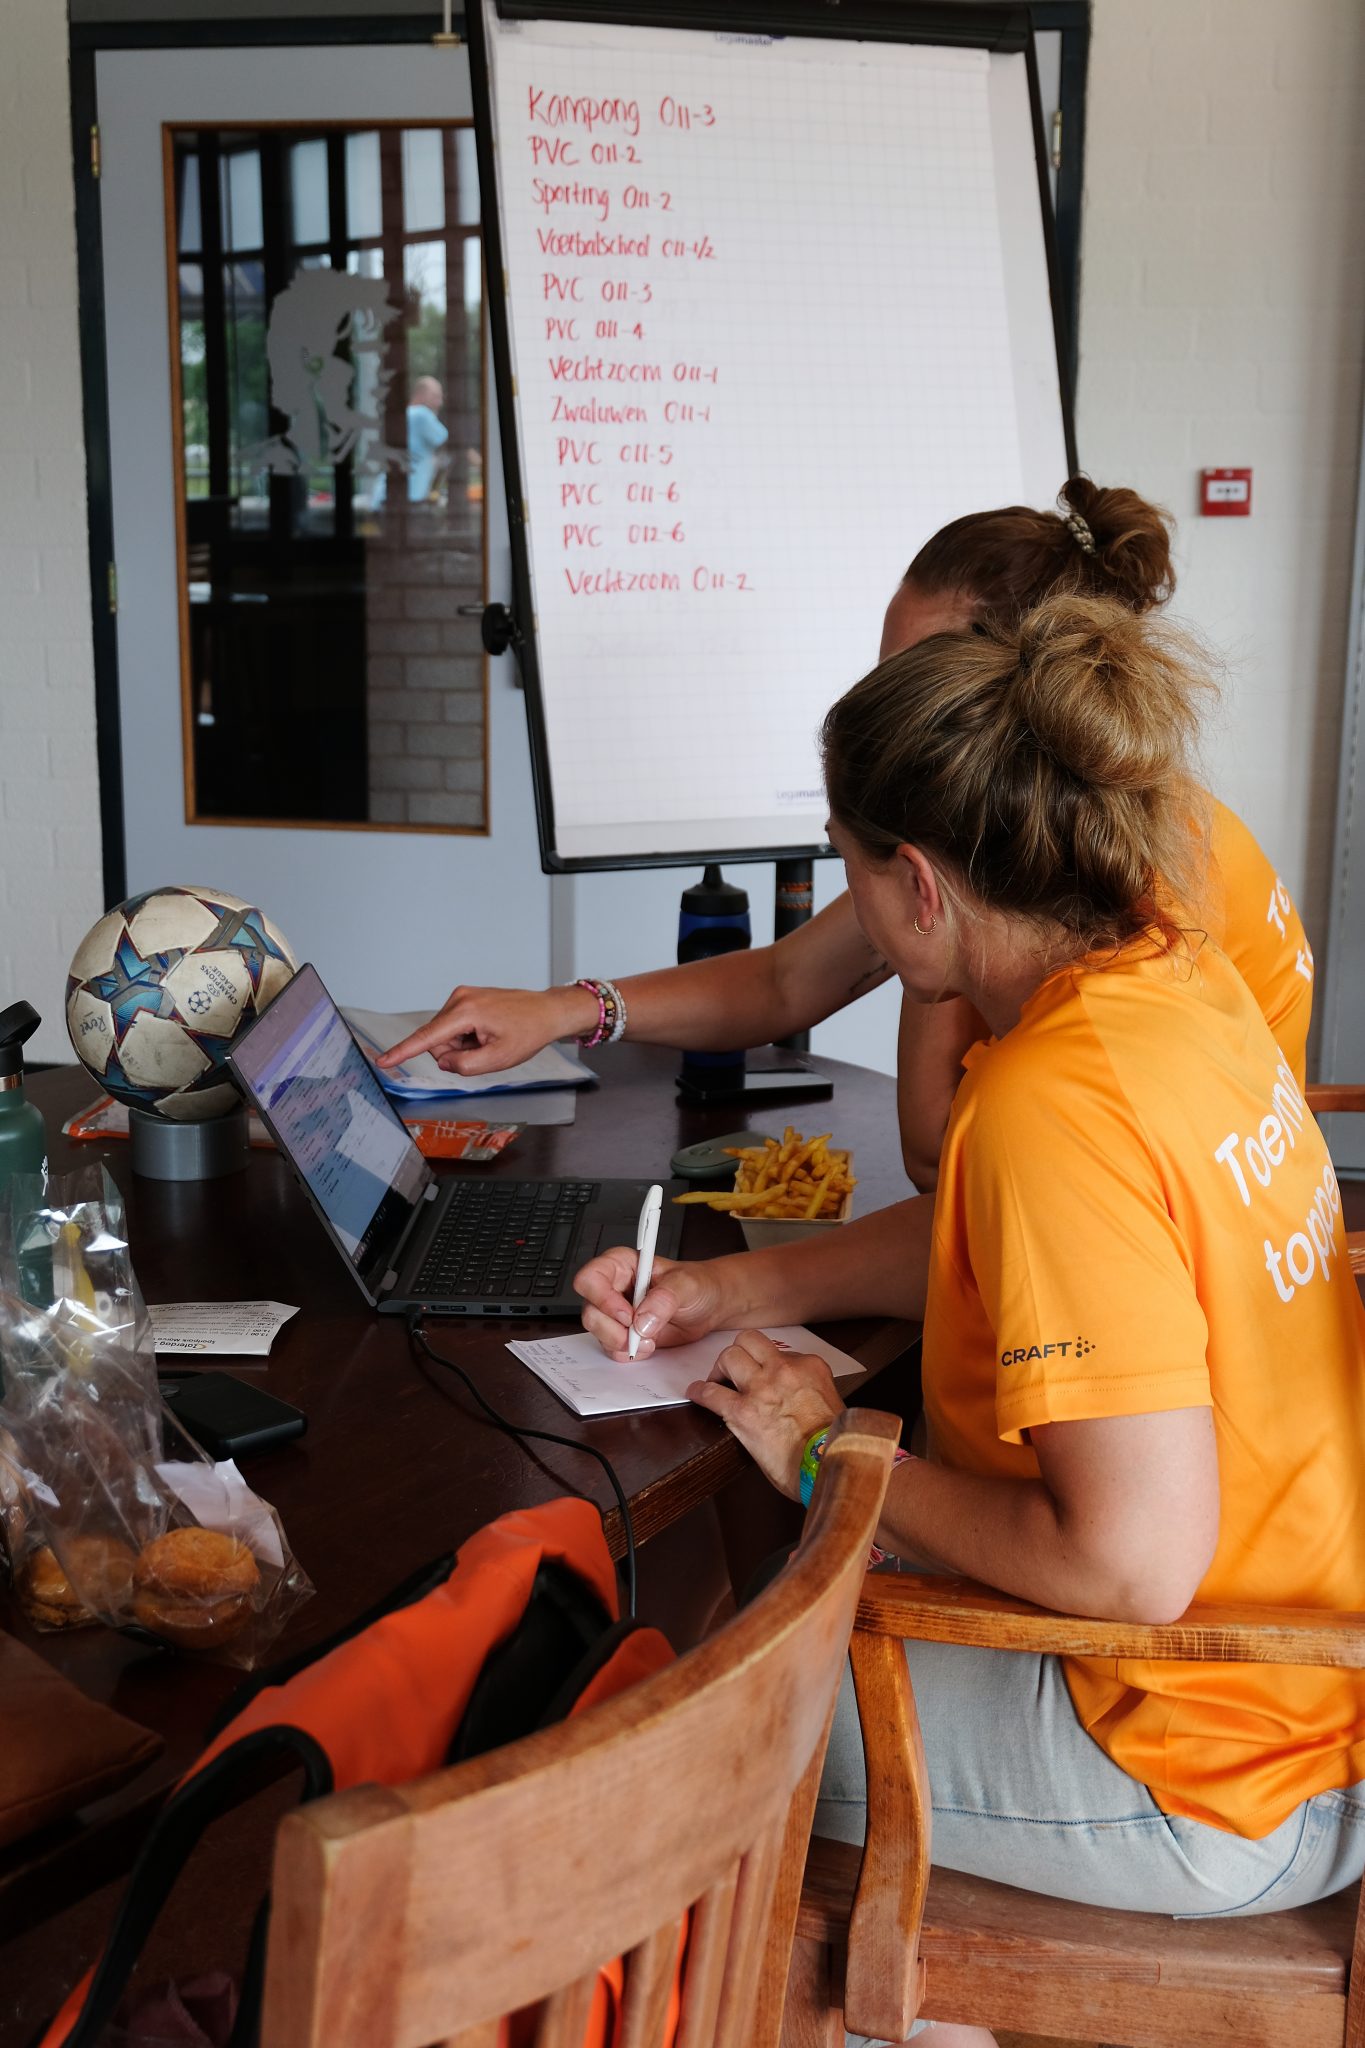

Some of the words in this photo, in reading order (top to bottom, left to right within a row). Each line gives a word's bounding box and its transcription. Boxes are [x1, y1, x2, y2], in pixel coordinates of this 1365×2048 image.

[528, 84, 640, 137] Kampong
[527, 134, 581, 166] PVC
[531, 177, 610, 223] Sporting
[542, 272, 584, 302] PVC
[545, 317, 581, 340] PVC
[548, 355, 662, 383] Vechtzoom
[550, 395, 648, 425] Zwaluwen
[557, 436, 603, 466] PVC
[560, 481, 604, 508] PVC
[563, 523, 604, 550] PVC
[563, 567, 681, 597] Vechtzoom
[200, 964, 238, 1005] CHAMPIONS
[212, 965, 237, 994] LEAGUE
[1263, 1150, 1341, 1303] toppe
[1001, 1341, 1073, 1367] CRAFT
